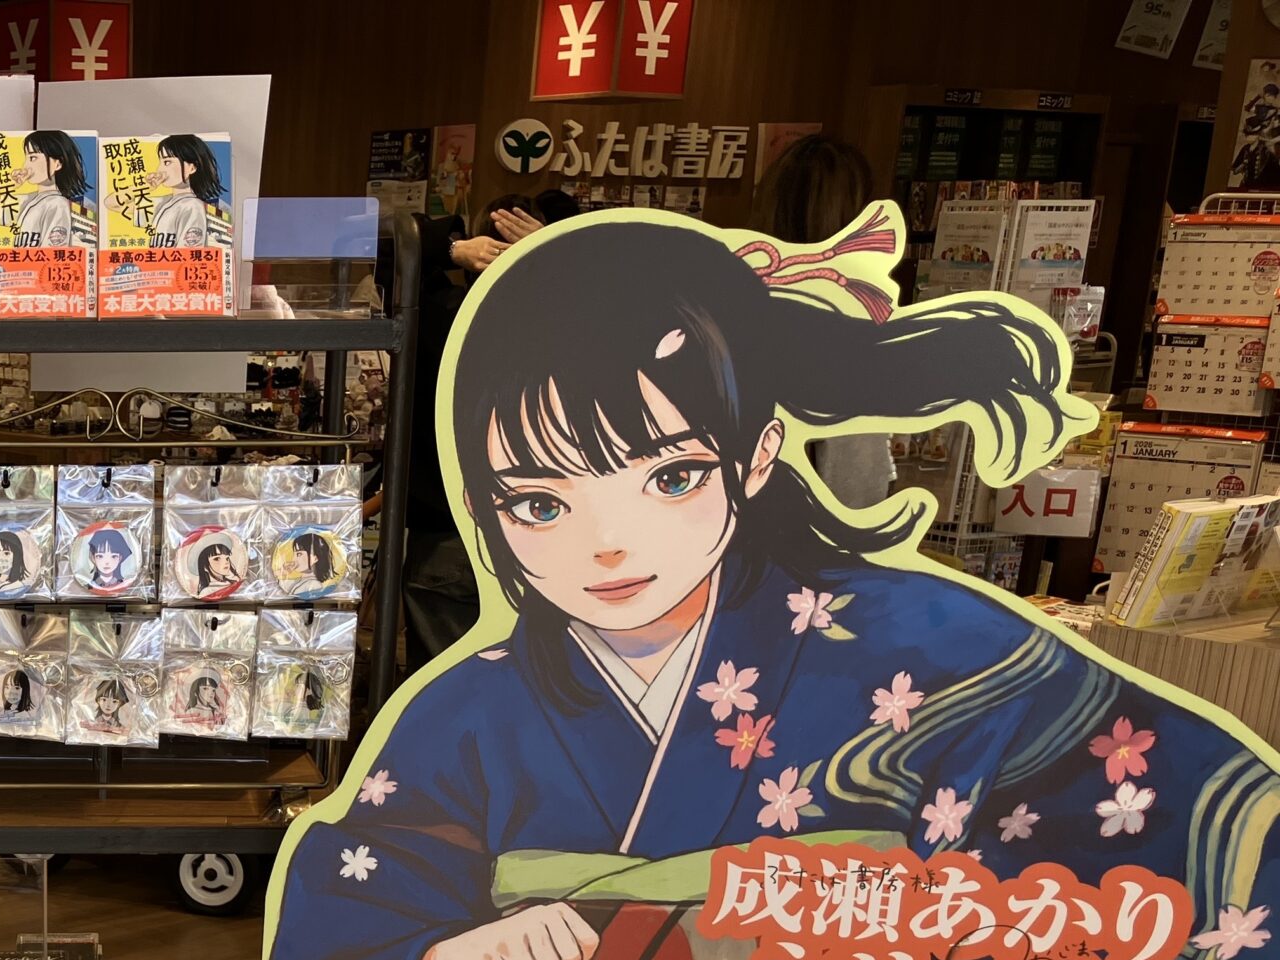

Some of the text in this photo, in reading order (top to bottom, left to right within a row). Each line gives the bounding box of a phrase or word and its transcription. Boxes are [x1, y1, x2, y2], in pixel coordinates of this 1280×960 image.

[549, 118, 750, 179] ふたば書房
[108, 249, 220, 264] 最高の主人公、現る!
[103, 293, 223, 313] 本屋大賞受賞作
[1133, 447, 1179, 460] JANUARY
[1001, 483, 1078, 518] 入口
